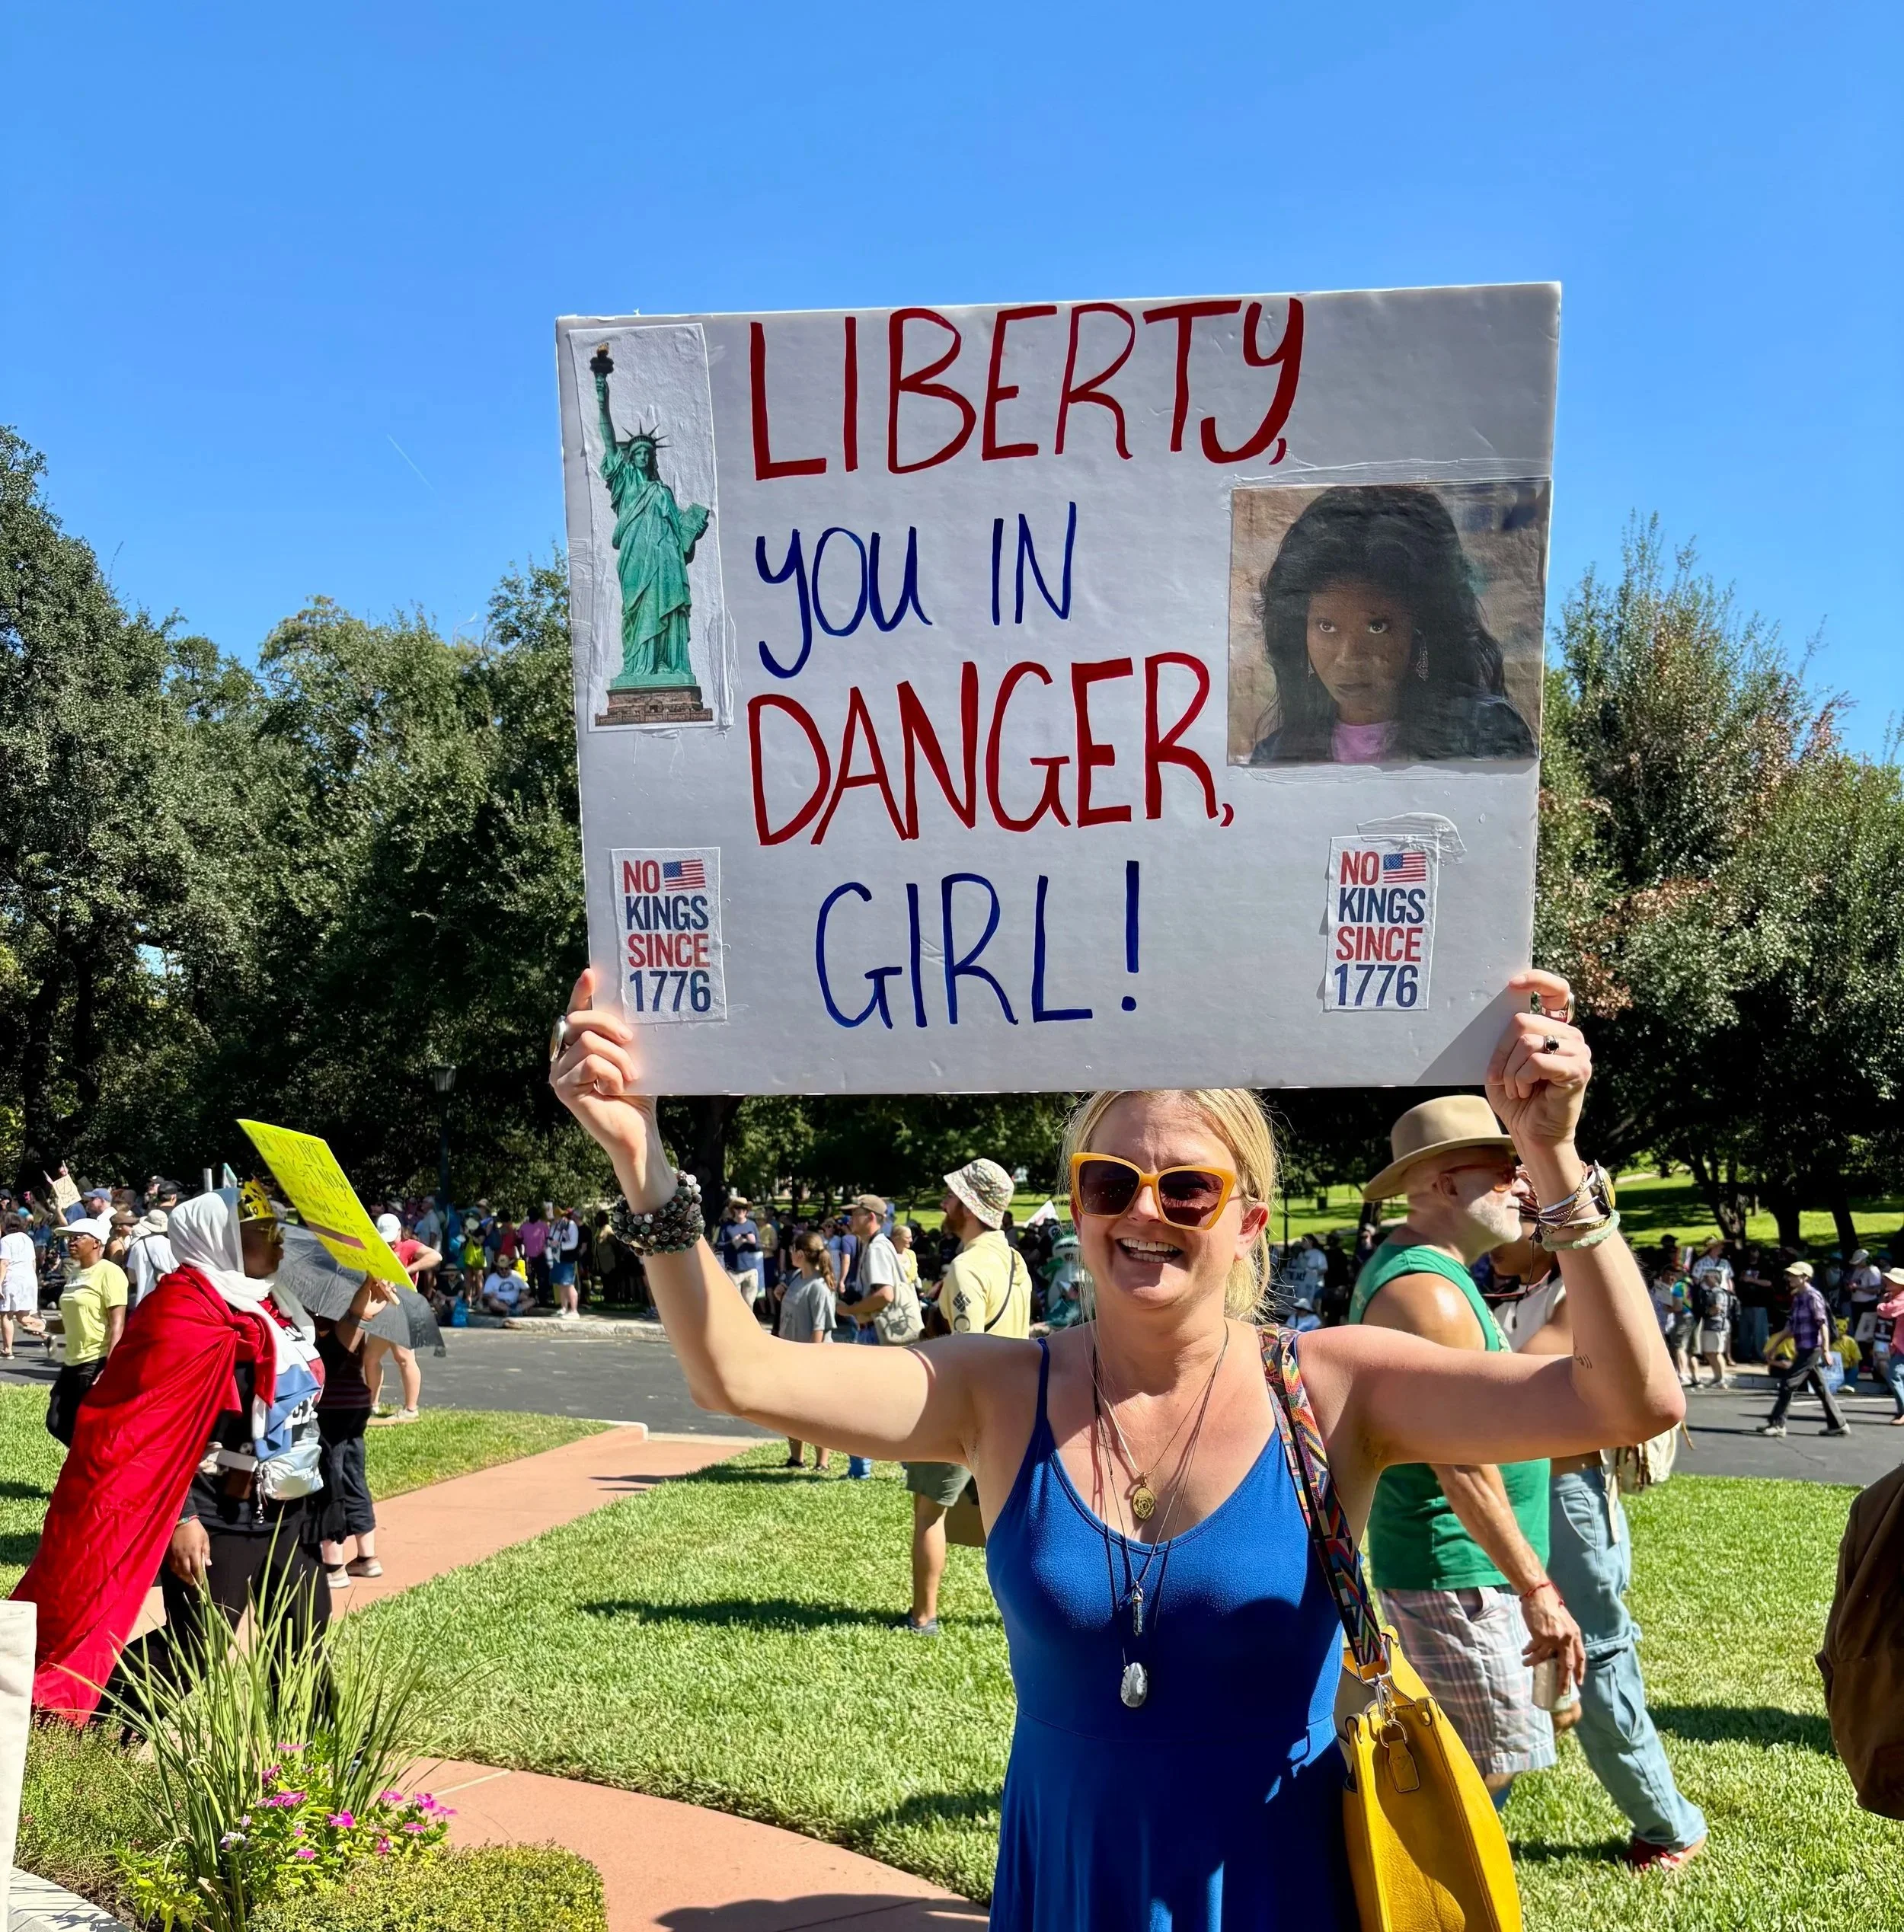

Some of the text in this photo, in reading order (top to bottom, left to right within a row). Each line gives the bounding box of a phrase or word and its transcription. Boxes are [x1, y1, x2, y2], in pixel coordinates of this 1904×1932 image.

[750, 299, 1303, 480] LIBERTY,
[991, 502, 1078, 628] IN
[747, 652, 1234, 846] DANGER,
[623, 859, 661, 894] NO
[1340, 851, 1378, 886] NO
[626, 896, 710, 931] KINGS
[1338, 888, 1426, 924] KINGS
[628, 934, 711, 968] SINCE
[815, 862, 1140, 1030] GIRL!
[1336, 926, 1423, 962] SINCE
[629, 971, 712, 1014] 1776
[1334, 964, 1418, 1008] 1776
